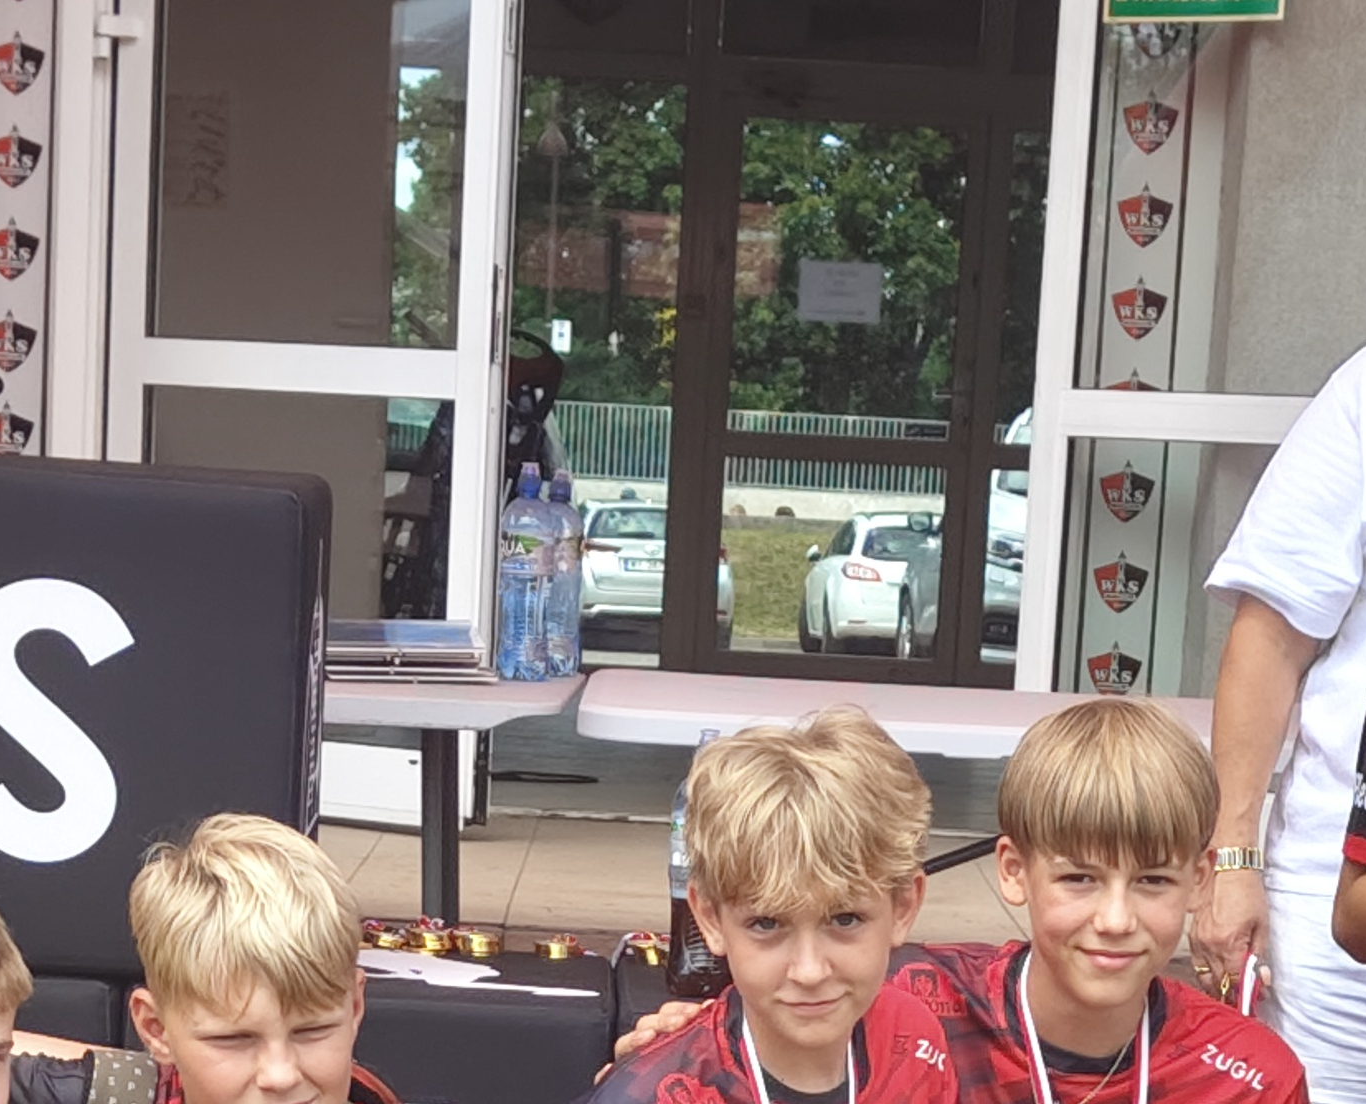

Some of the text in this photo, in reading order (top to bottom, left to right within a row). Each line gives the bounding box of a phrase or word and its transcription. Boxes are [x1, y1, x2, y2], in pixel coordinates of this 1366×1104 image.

[1106, 488, 1146, 502] WKS
[1101, 579, 1140, 593] WKS
[1094, 669, 1133, 683] WKS
[1200, 1043, 1265, 1091] ZUGIL
